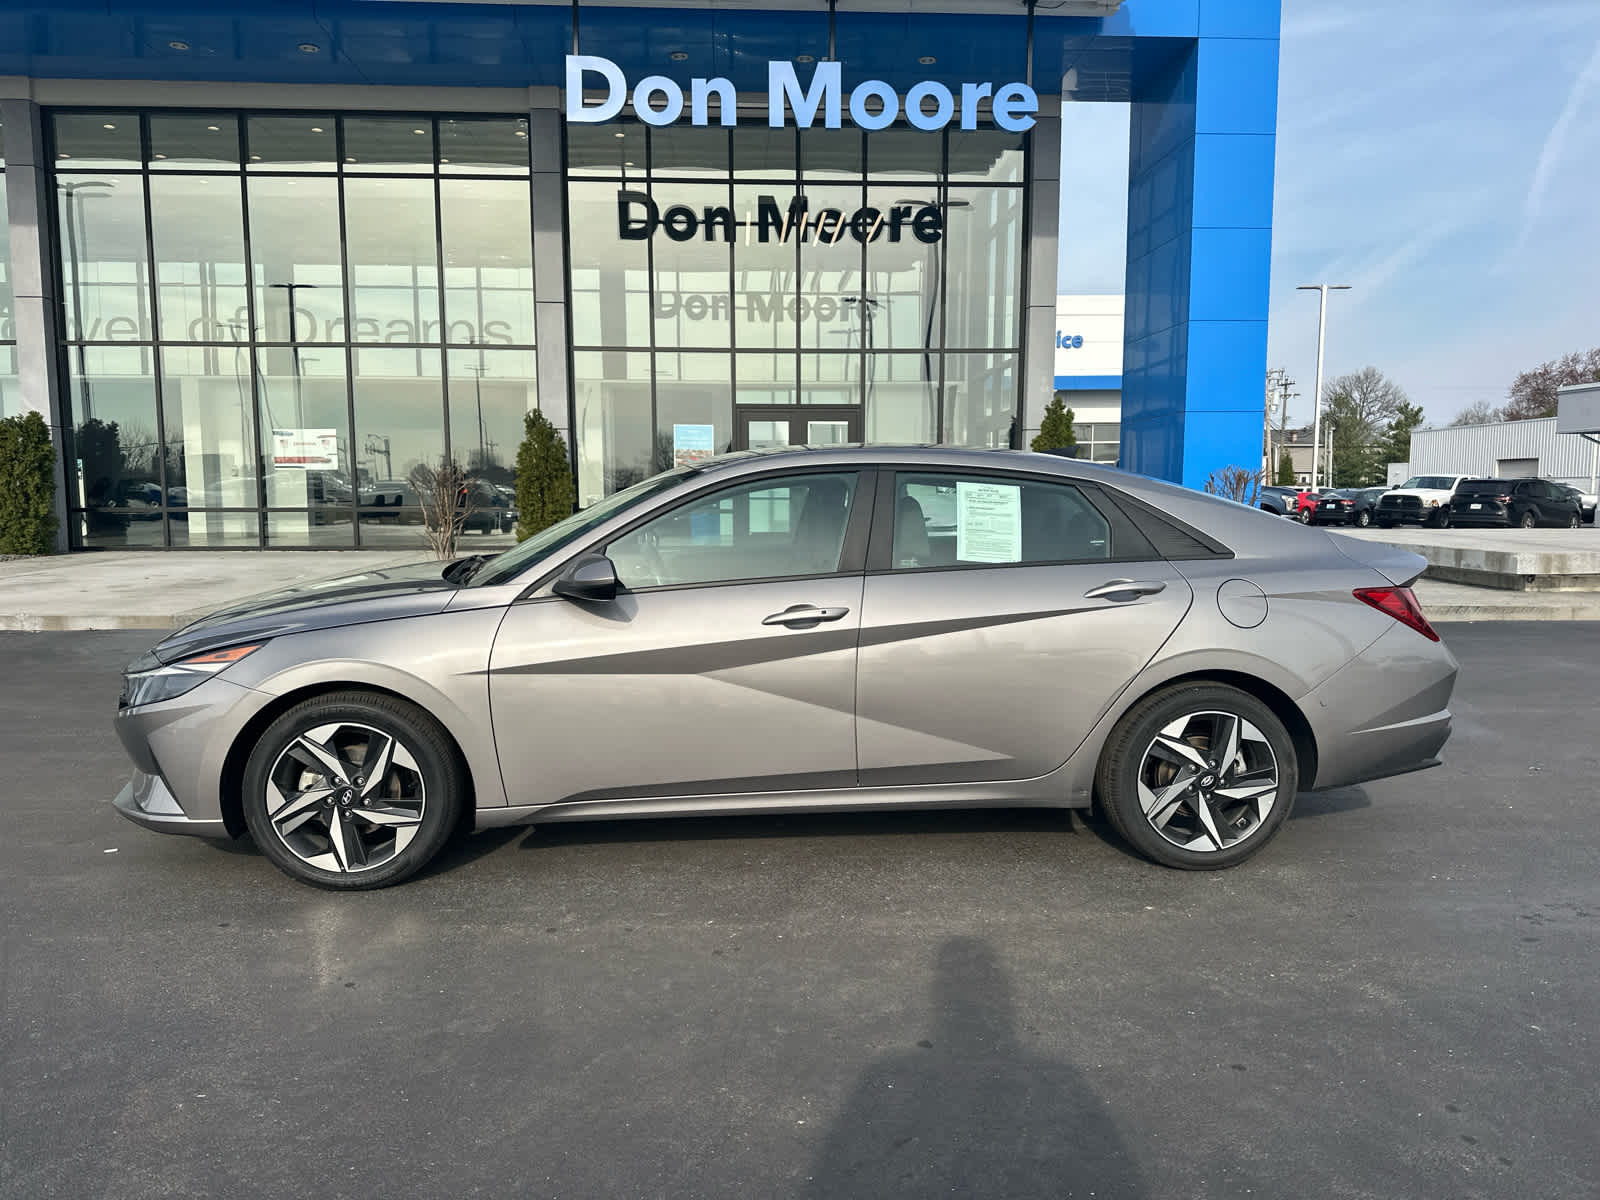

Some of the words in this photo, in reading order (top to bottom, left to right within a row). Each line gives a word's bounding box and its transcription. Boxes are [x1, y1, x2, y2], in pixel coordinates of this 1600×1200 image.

[566, 55, 737, 127] Don
[768, 61, 1039, 132] Moore
[618, 190, 736, 241] Don
[757, 195, 942, 244] Moore
[655, 291, 731, 321] Don
